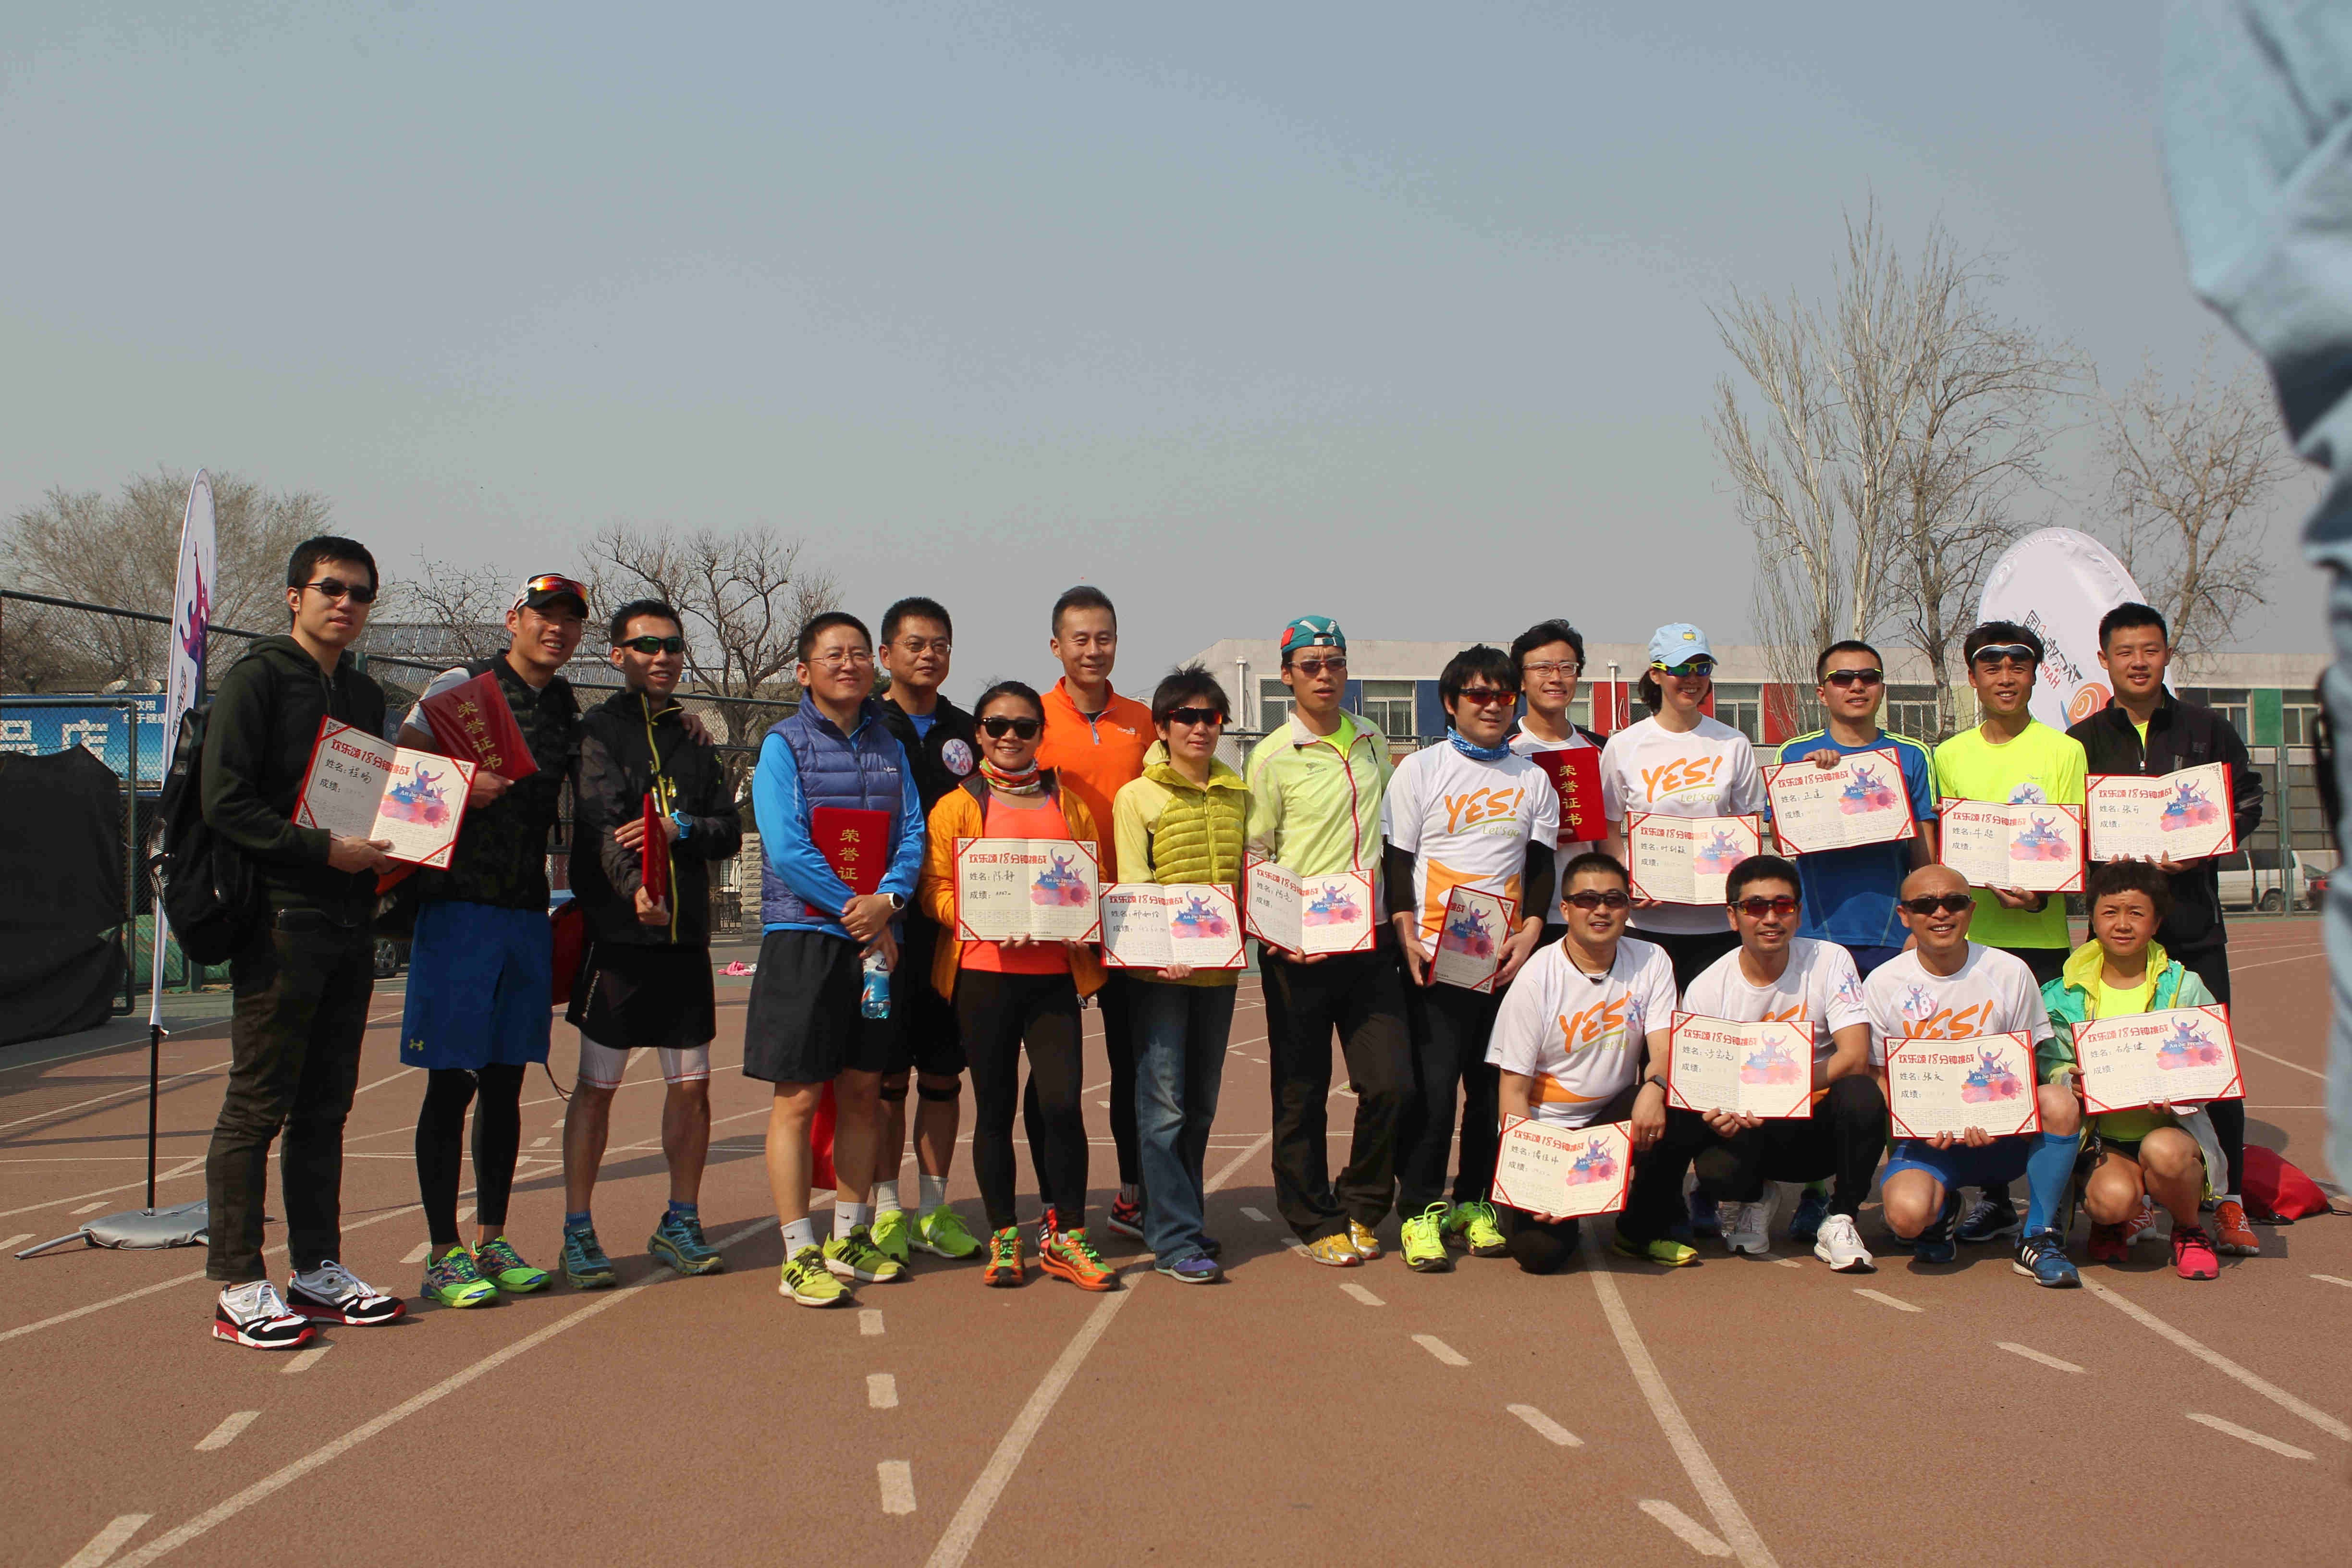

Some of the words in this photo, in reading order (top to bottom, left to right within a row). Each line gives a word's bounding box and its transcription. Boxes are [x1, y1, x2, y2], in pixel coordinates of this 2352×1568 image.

[457, 701, 502, 770] 荣誉证书
[331, 739, 411, 776] 欢乐颂18分钟挑战
[1642, 755, 1723, 803] YES!
[1777, 770, 1849, 788] 欢乐颂18分钟挑战
[1558, 764, 1583, 826] 荣誉证书
[2098, 788, 2173, 799] 欢乐颂18分钟挑战
[1445, 787, 1525, 834] YES!
[1952, 812, 2027, 827] 欢乐颂18分钟挑战
[837, 829, 860, 894] 荣誉证
[968, 853, 1047, 864] 欢乐颂18分钟挑战
[1257, 869, 1319, 896] 欢乐颂18分钟挑战
[1109, 894, 1184, 906] 欢乐颂18分钟挑战
[1683, 1028, 1758, 1046] 欢乐颂18分钟挑战
[2087, 1023, 2169, 1043] 欢乐颂18分钟挑战
[1898, 1054, 1975, 1065] 欢乐颂18分钟挑战
[1514, 1128, 1584, 1153] 欢乐颂18分钟挑战
